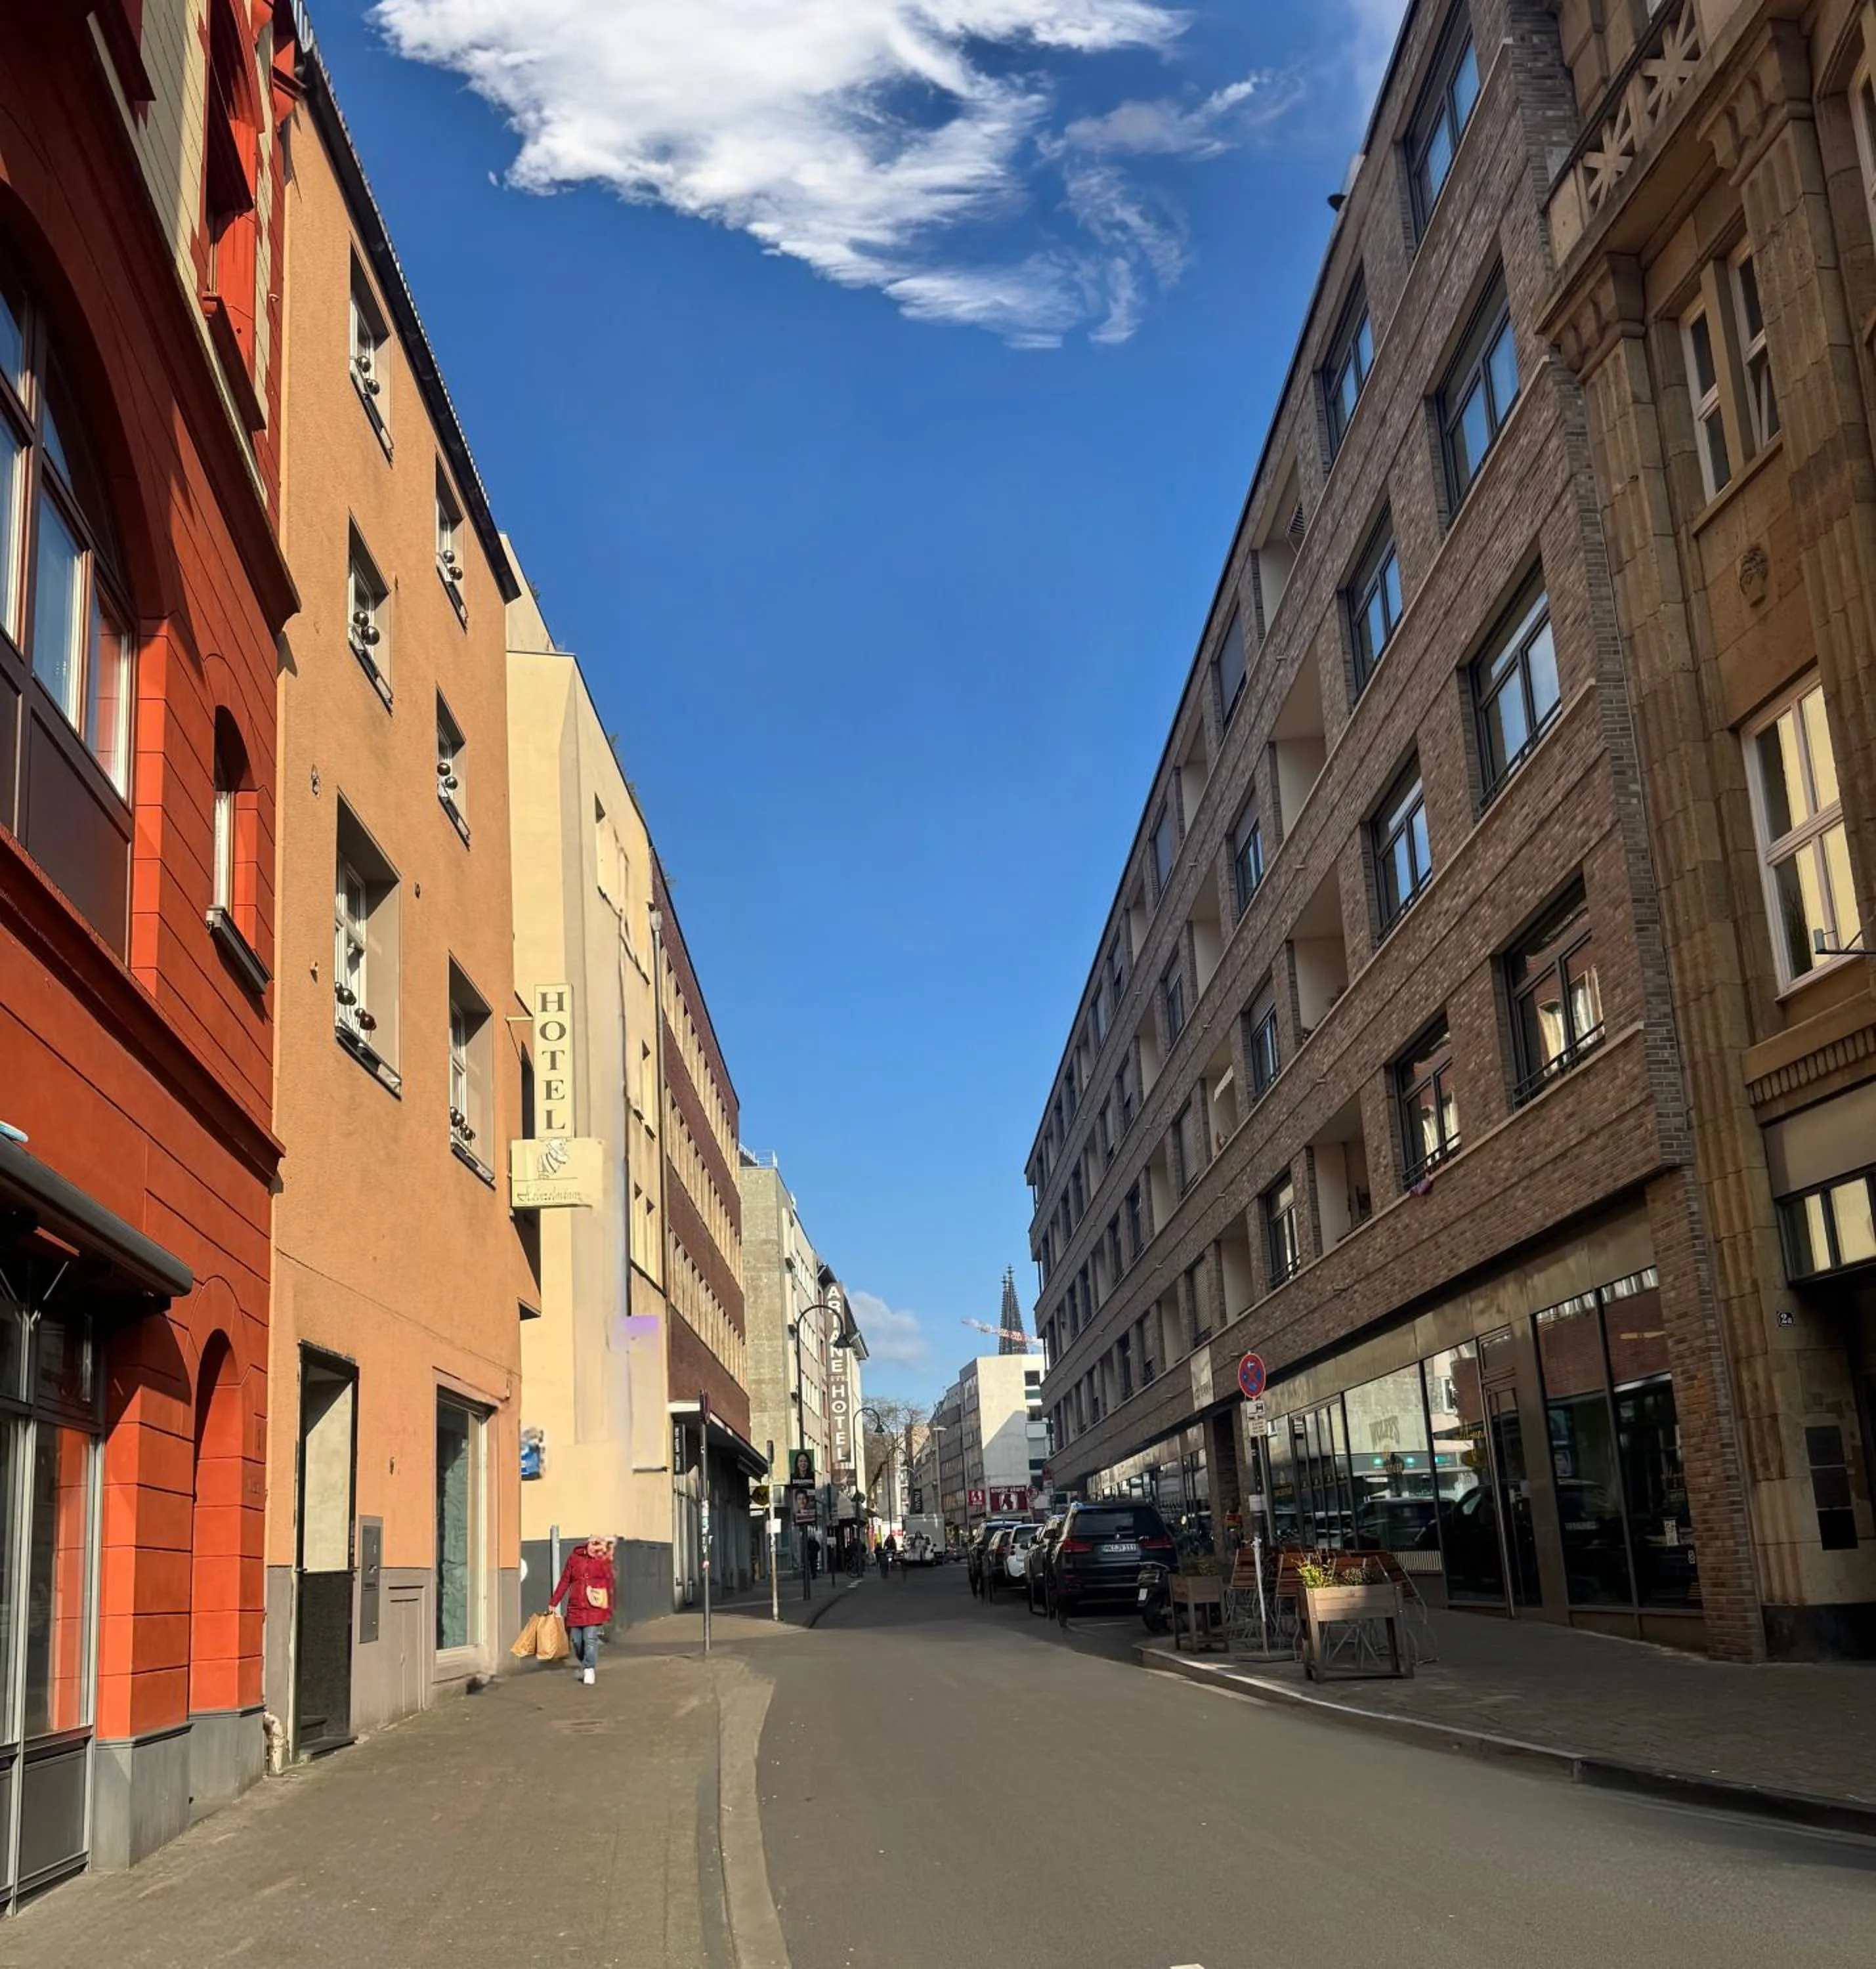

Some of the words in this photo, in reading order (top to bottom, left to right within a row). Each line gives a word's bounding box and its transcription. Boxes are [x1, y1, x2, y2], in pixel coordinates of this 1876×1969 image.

[538, 992, 566, 1130] HOTEL
[827, 1286, 843, 1372] ARIANE
[832, 1384, 847, 1460] HOTEL
